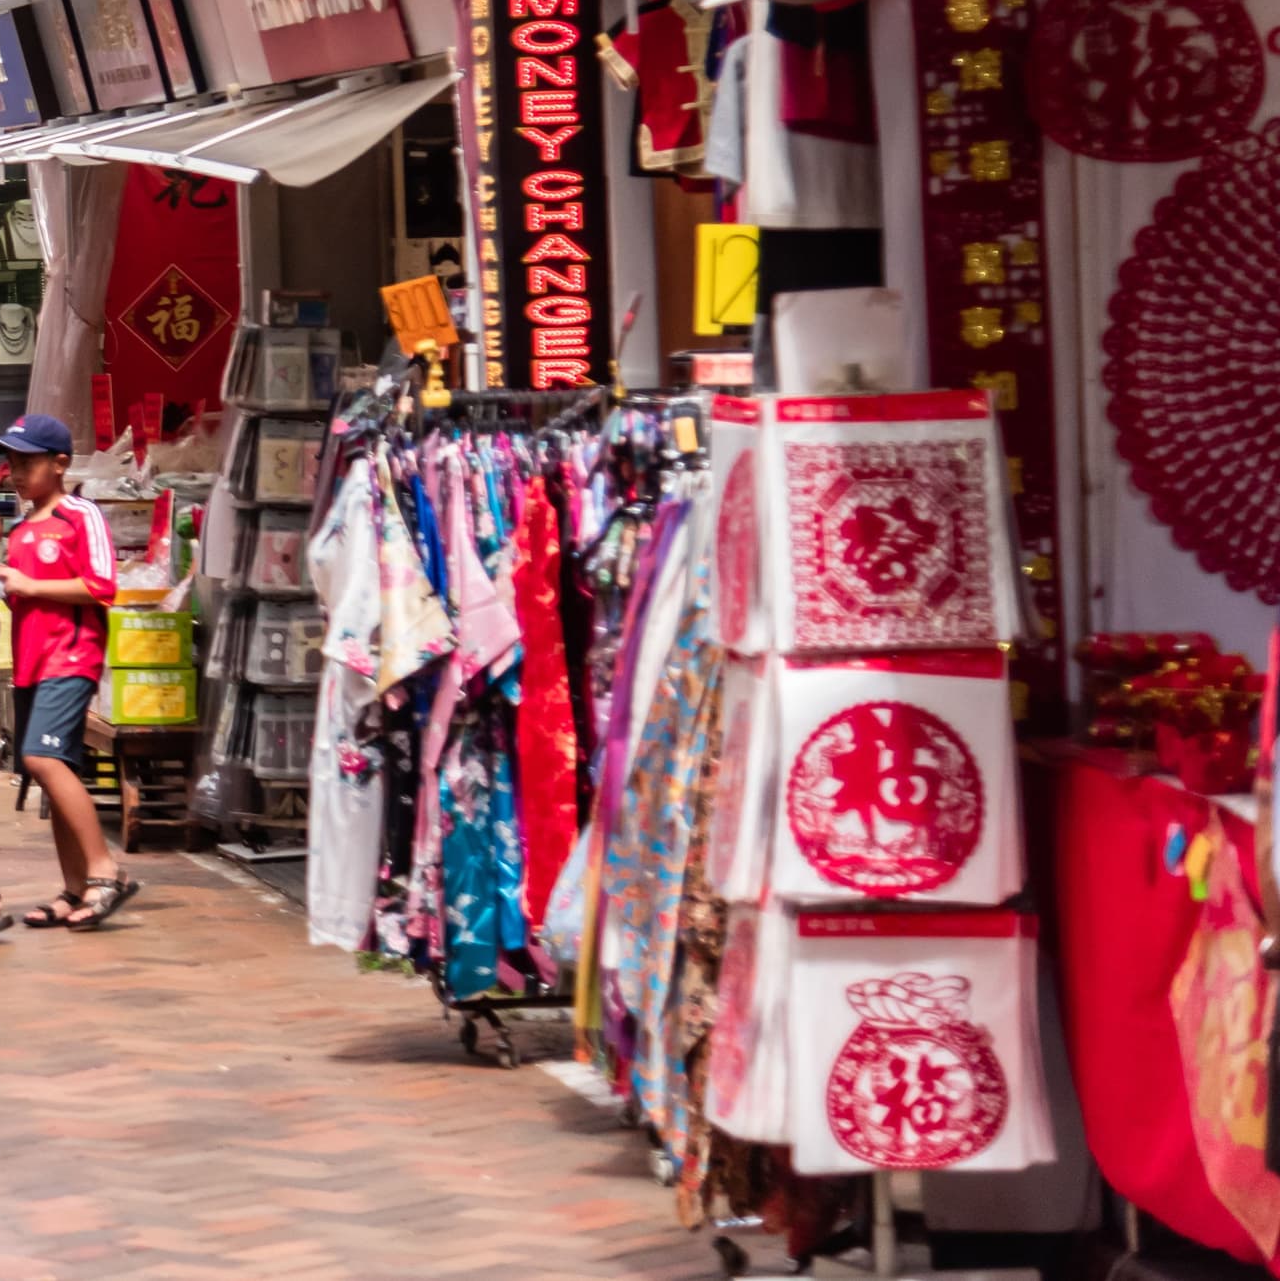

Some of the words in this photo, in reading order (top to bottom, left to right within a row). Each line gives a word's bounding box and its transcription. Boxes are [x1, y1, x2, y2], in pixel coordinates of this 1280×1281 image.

[146, 294, 201, 344] 福
[477, 173, 505, 388] CHANGER
[519, 170, 597, 390] CHANGER
